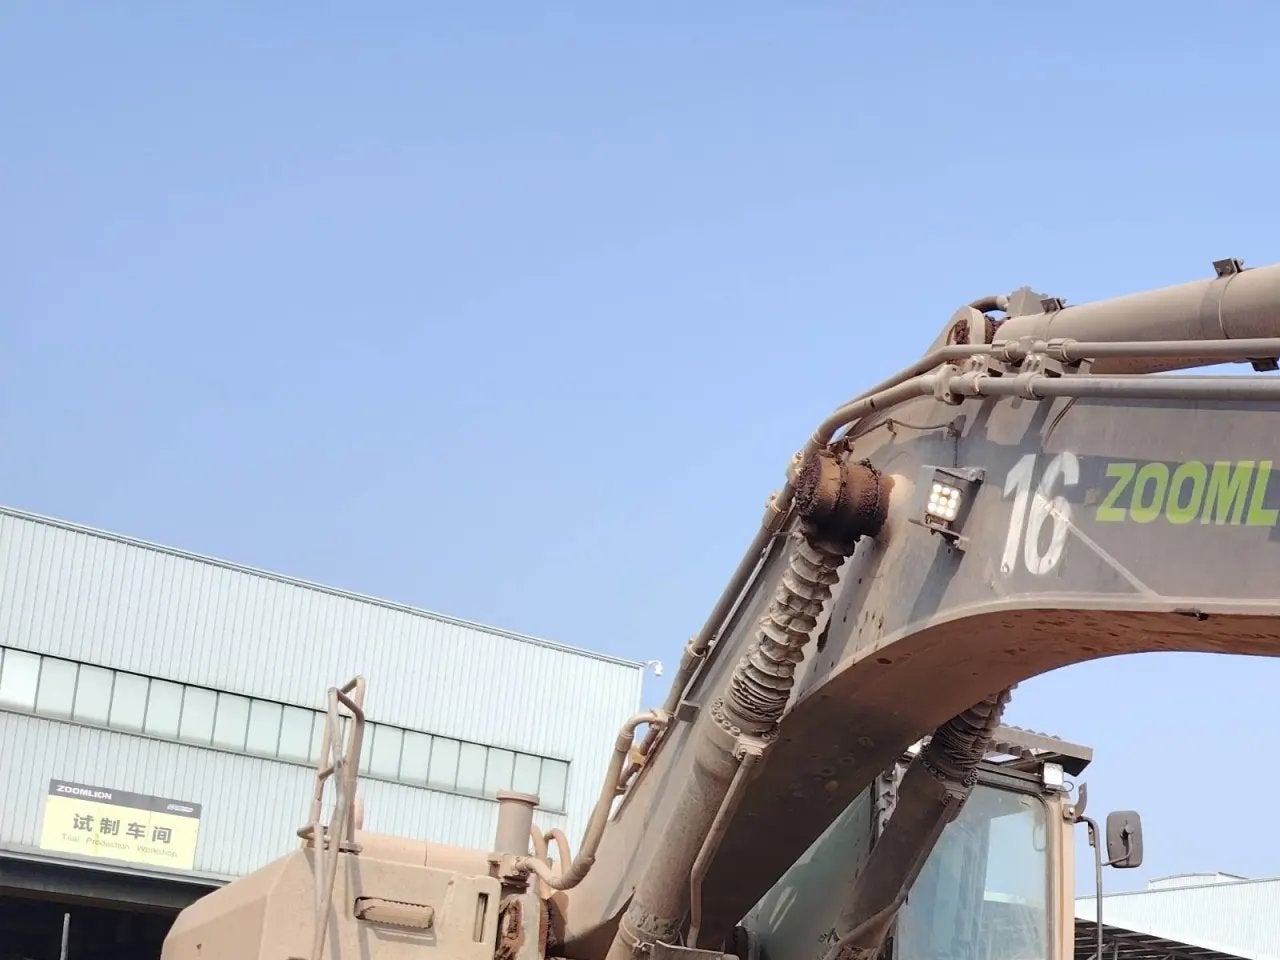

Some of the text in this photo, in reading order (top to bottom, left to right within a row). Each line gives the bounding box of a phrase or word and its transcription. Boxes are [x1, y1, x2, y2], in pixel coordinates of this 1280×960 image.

[1000, 452, 1080, 575] 16
[56, 784, 112, 800] ZOOMLION
[73, 813, 172, 844] 试制车间
[86, 835, 131, 850] Production
[137, 844, 178, 857] Workshop
